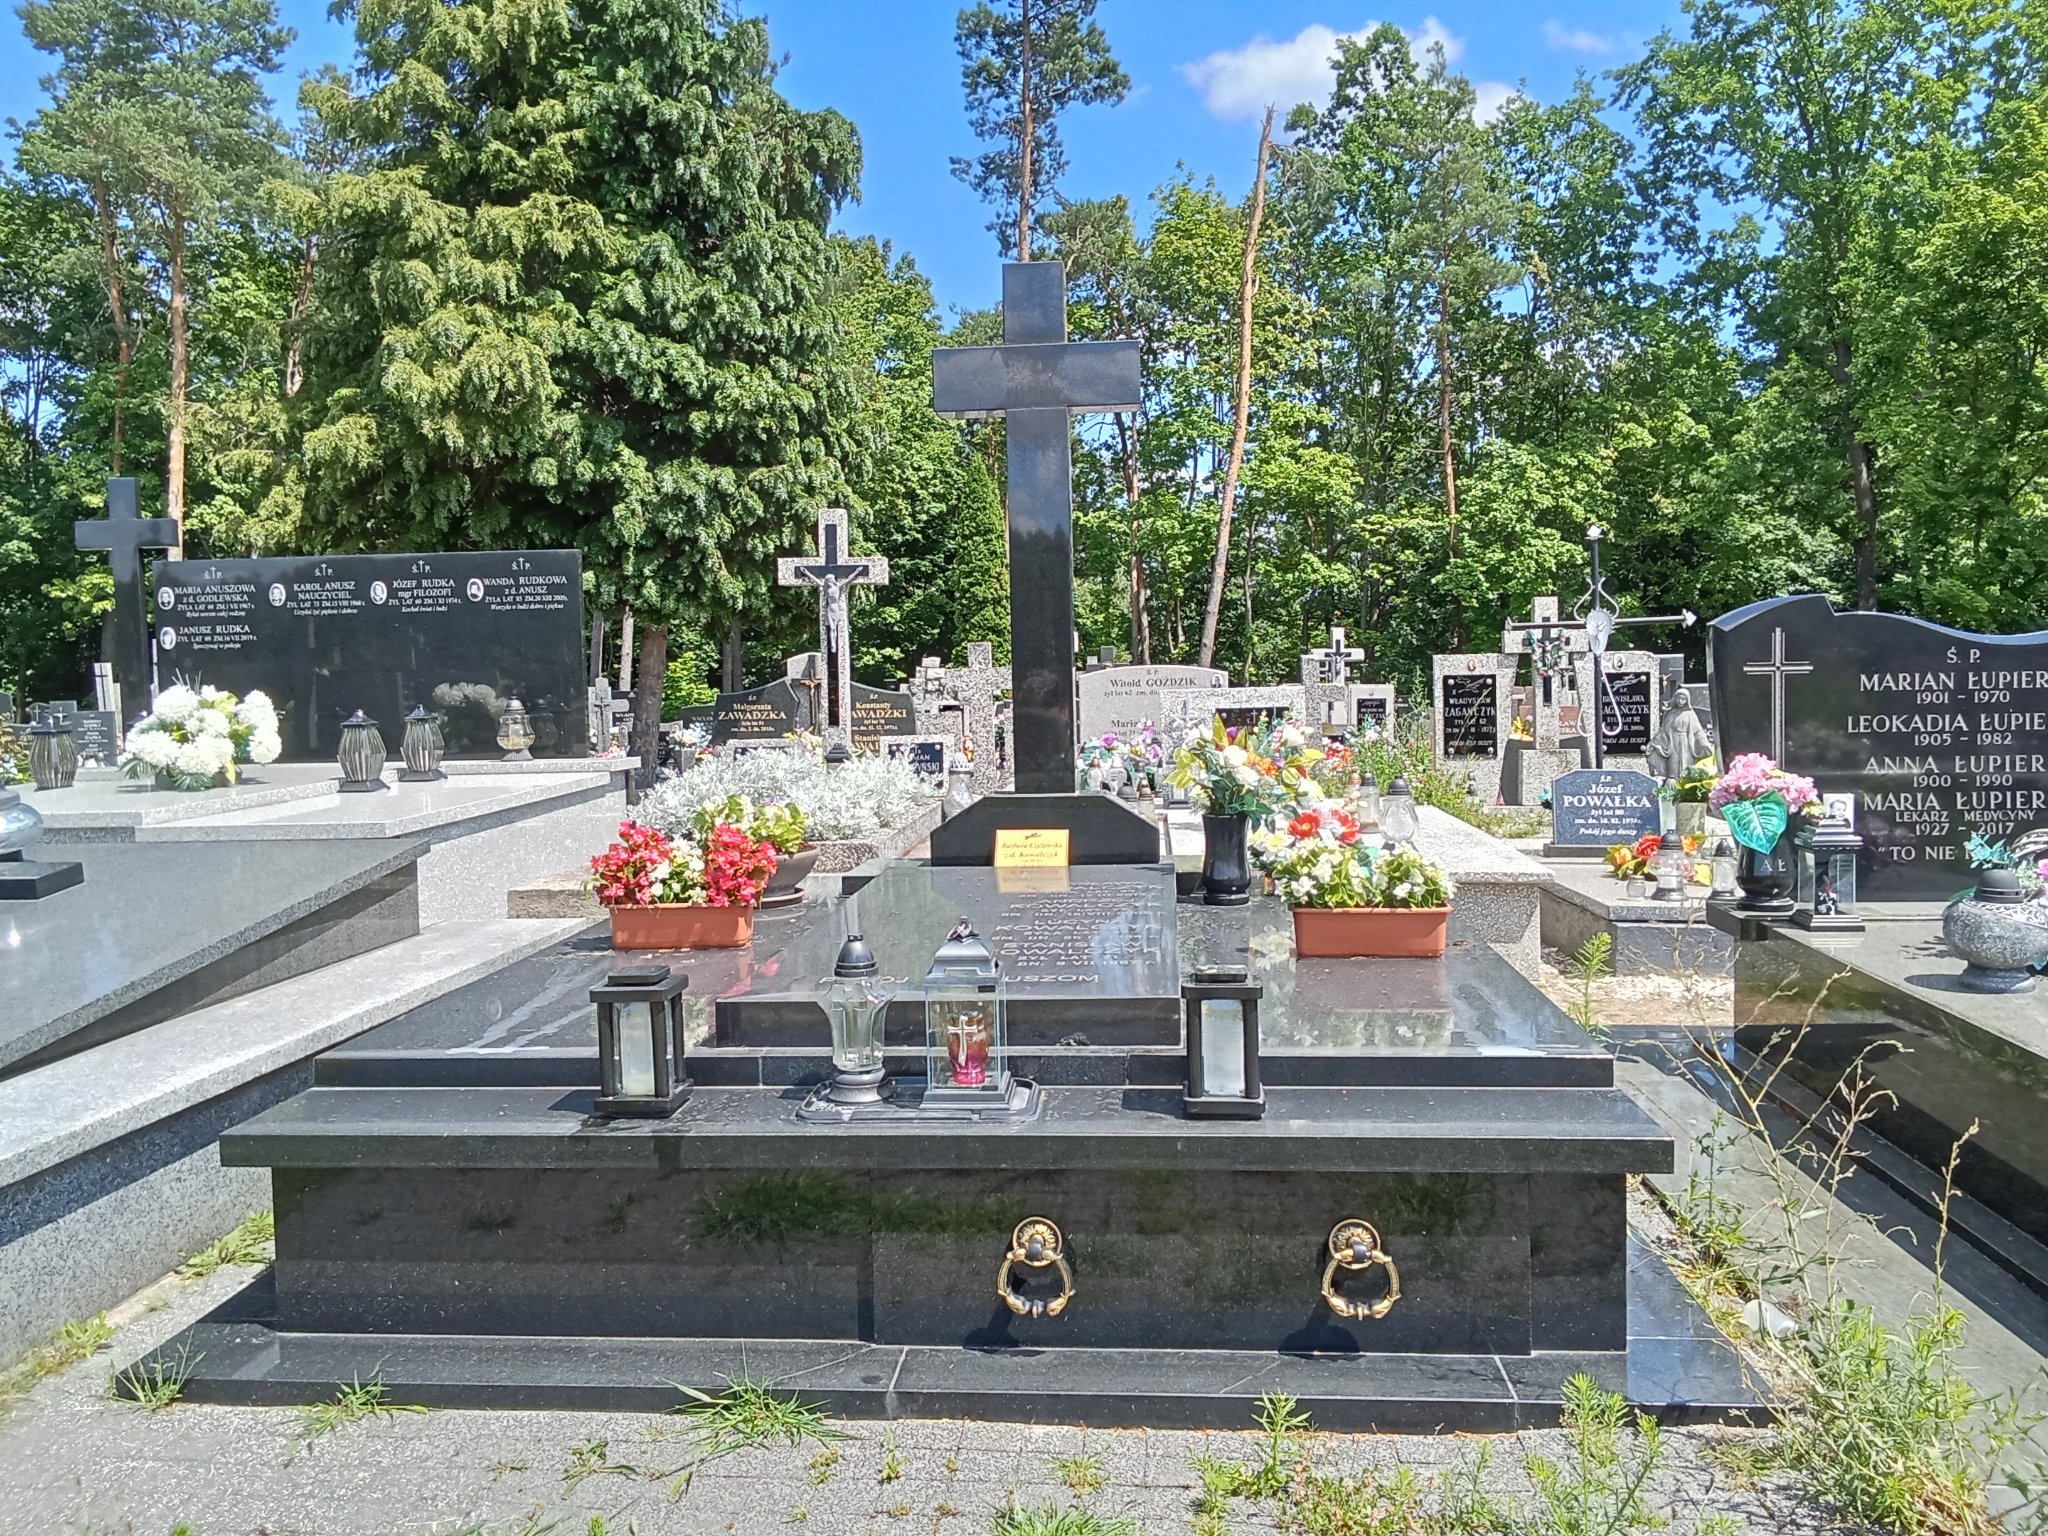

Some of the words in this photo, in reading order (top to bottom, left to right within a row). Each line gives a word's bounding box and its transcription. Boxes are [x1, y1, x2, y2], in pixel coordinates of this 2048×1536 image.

[392, 578, 417, 588] JÓZEF
[421, 578, 456, 587] RUDKA
[483, 577, 516, 586] WANDA
[519, 575, 568, 584] RUDKOWA
[174, 586, 202, 594] MARIA
[205, 584, 256, 593] ANUSZOWA
[293, 583, 322, 591] KAROL
[324, 581, 356, 590] ANUSZ
[519, 586, 548, 594] ANUSZ
[196, 594, 249, 602] GODLEWSKA
[298, 591, 352, 600] NAUCZYCIEL
[397, 590, 412, 599] mgr
[413, 588, 451, 597] FILOZOFI
[179, 626, 212, 634] JANUSZ
[216, 624, 250, 633] RUDKA
[1946, 645, 1961, 664] Ś.
[1968, 648, 1980, 663] P.
[1109, 679, 1142, 688] Witold
[1859, 671, 1954, 692] MARIAN
[1966, 670, 2048, 689] ŁUPIER
[1602, 694, 1645, 703] BRNISŁAWA
[1915, 691, 1948, 704] 1901
[1973, 690, 2010, 703] 1970
[732, 703, 772, 711] Małgorzata
[855, 701, 892, 710] Konstanty
[718, 710, 787, 720] ZAWADZKA
[851, 709, 908, 719] AWADZKI
[1847, 713, 1969, 733] LEOKADIA
[1979, 712, 2045, 731] ŁUPIE
[1913, 733, 1951, 746] 1905
[1976, 733, 2012, 745] 1982
[1864, 755, 1940, 774] ANNA
[1954, 754, 2047, 773] ŁUPIER
[1912, 774, 1951, 788] 1900
[1975, 774, 2012, 787] 1990
[1588, 784, 1624, 794] Józef
[1562, 795, 1651, 808] POWAŁKA
[1862, 792, 1941, 811] MARIA
[1955, 790, 2047, 810] ŁUPIER
[1590, 809, 1602, 817] żył
[1895, 811, 1948, 822] LEKARZ
[1963, 810, 2036, 822] MEDYCYNY
[1578, 827, 1600, 836] Pokój
[1616, 828, 1638, 836] duszy
[1915, 823, 1949, 836] 1927
[1978, 822, 2014, 836] 2017
[1924, 846, 1955, 860] NIE
[1760, 859, 1774, 872] A
[1777, 858, 1787, 872] Ł
[998, 947, 1160, 955] OWALCZYK
[1005, 974, 1100, 983] USZOM
